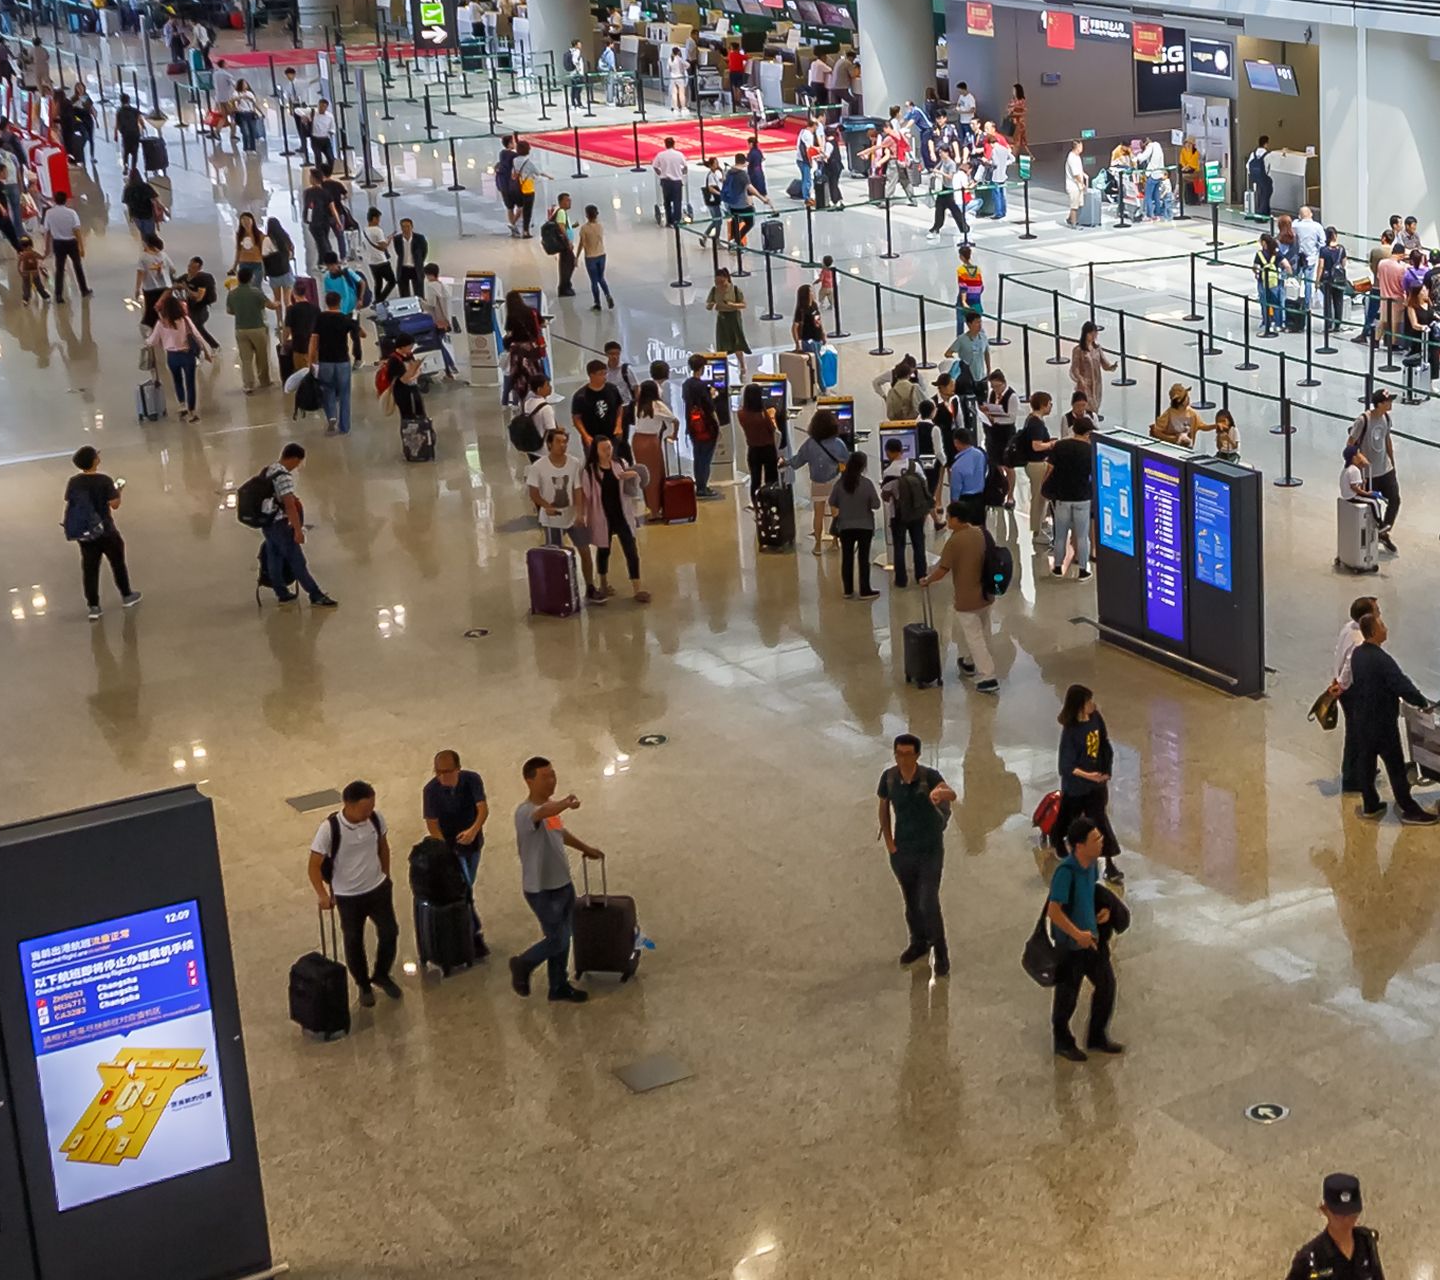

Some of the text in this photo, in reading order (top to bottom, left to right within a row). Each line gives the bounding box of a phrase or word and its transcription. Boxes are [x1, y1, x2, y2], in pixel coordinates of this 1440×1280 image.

[96, 976, 138, 992] Changsha
[98, 984, 139, 1001] Changsha
[99, 993, 140, 1010] Changsha
